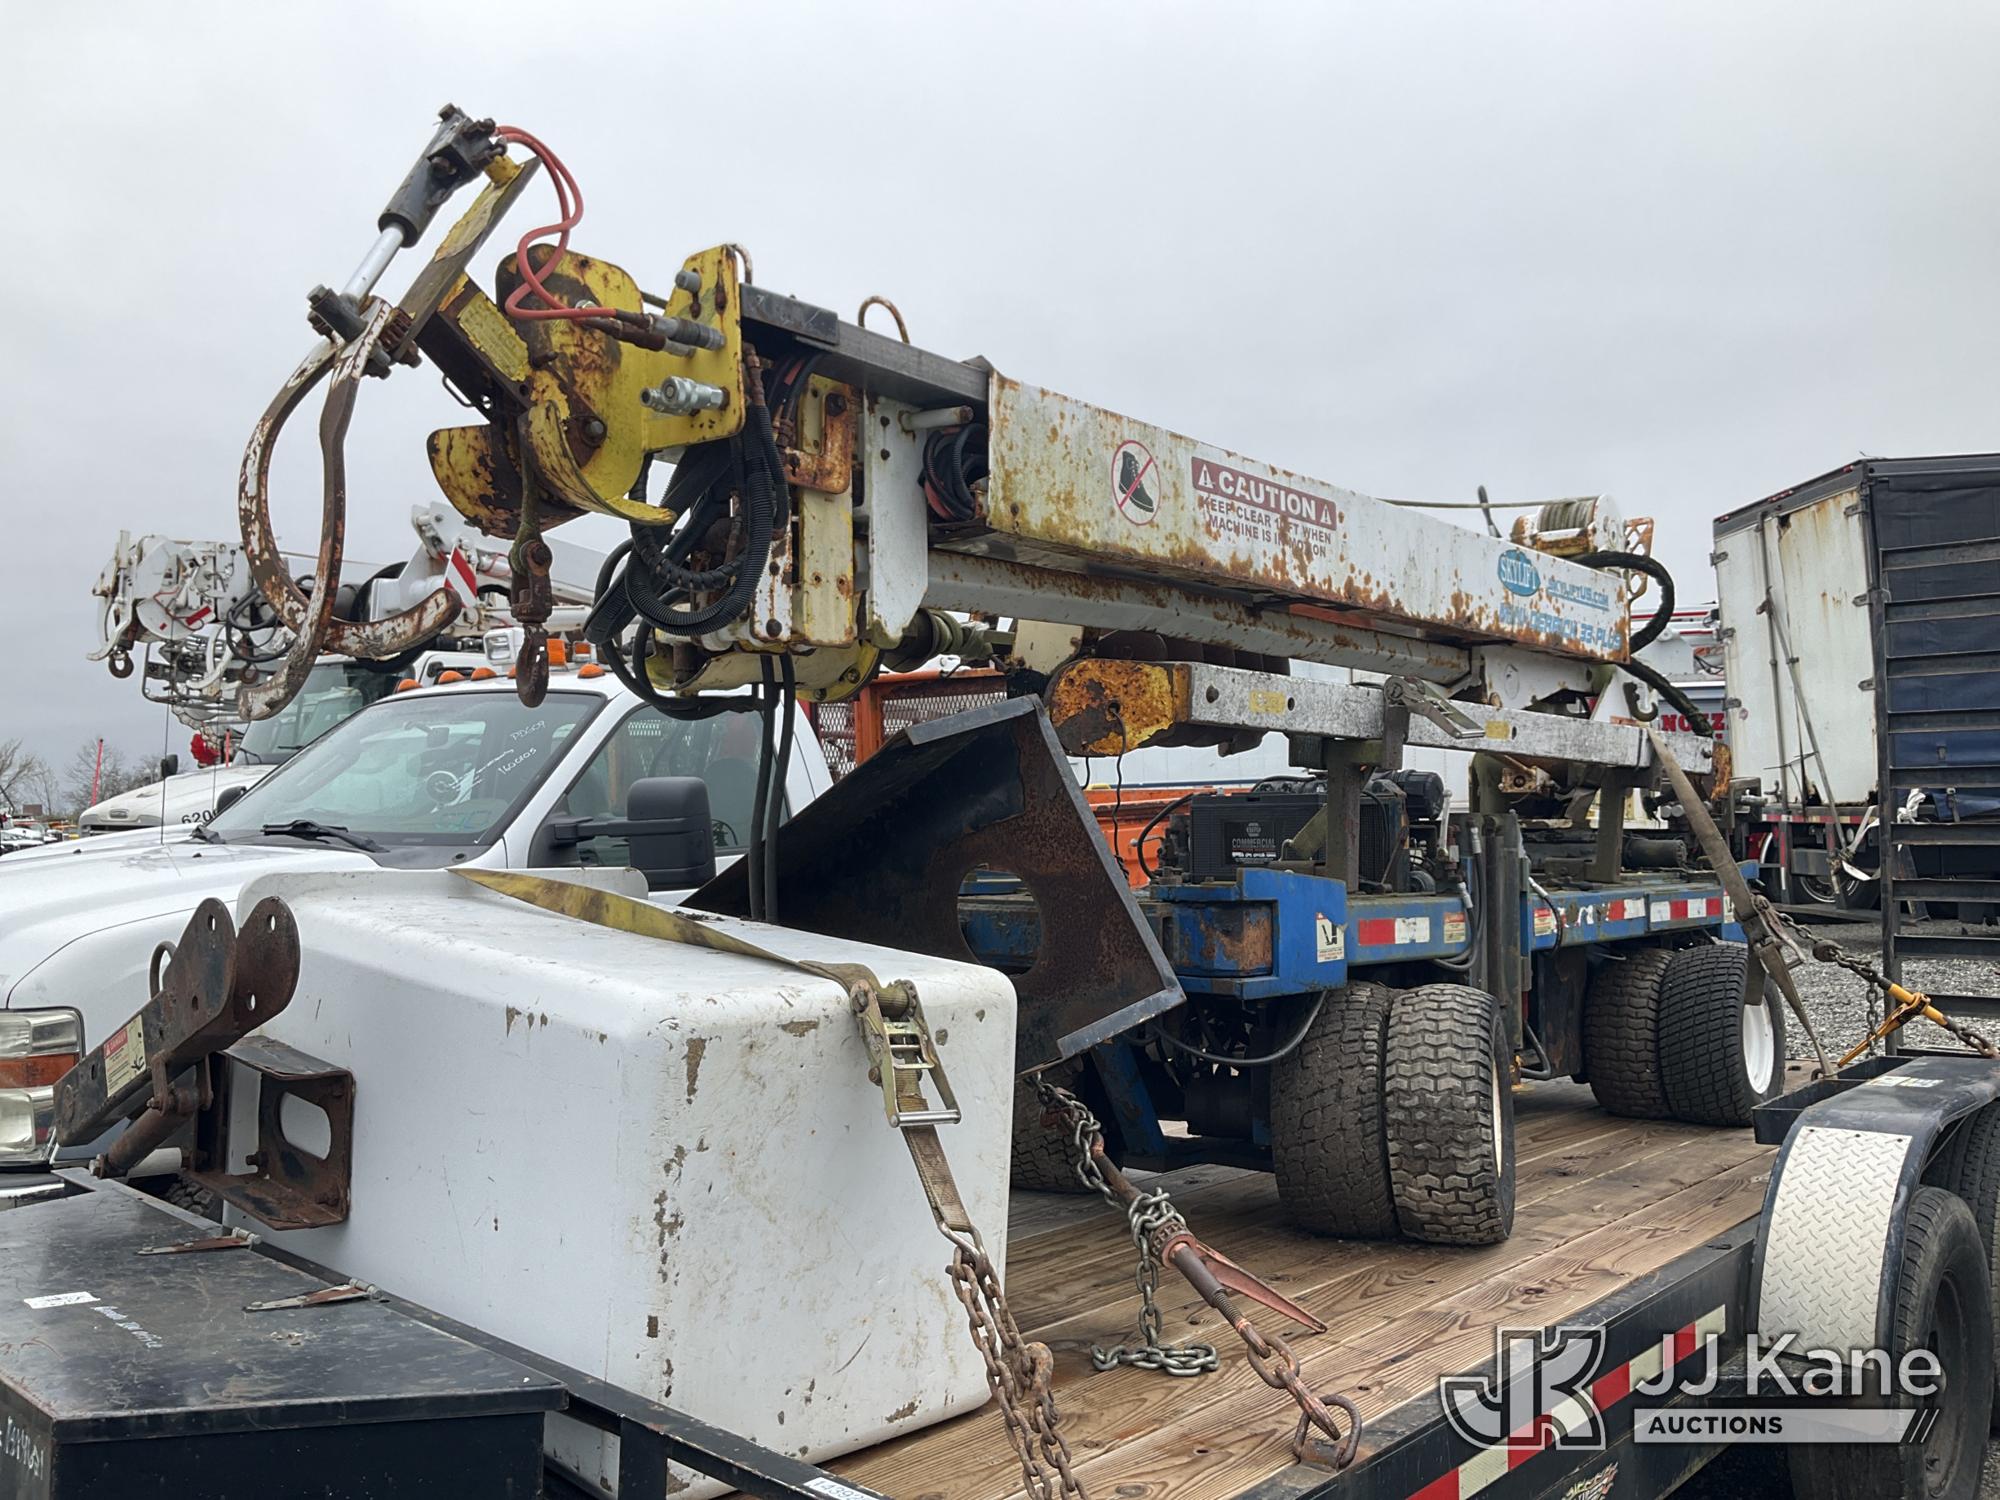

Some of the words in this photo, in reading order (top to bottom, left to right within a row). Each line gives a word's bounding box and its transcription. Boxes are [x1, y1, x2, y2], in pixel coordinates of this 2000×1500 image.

[1218, 470, 1317, 522] CAUTION
[1209, 514, 1259, 541] MACHINE
[1261, 528, 1273, 544] IS
[1236, 504, 1272, 529] CLEAR
[1302, 525, 1332, 546] WHEN
[1500, 557, 1536, 590] SKYLIFT
[1231, 838, 1276, 848] COMMERCIAL
